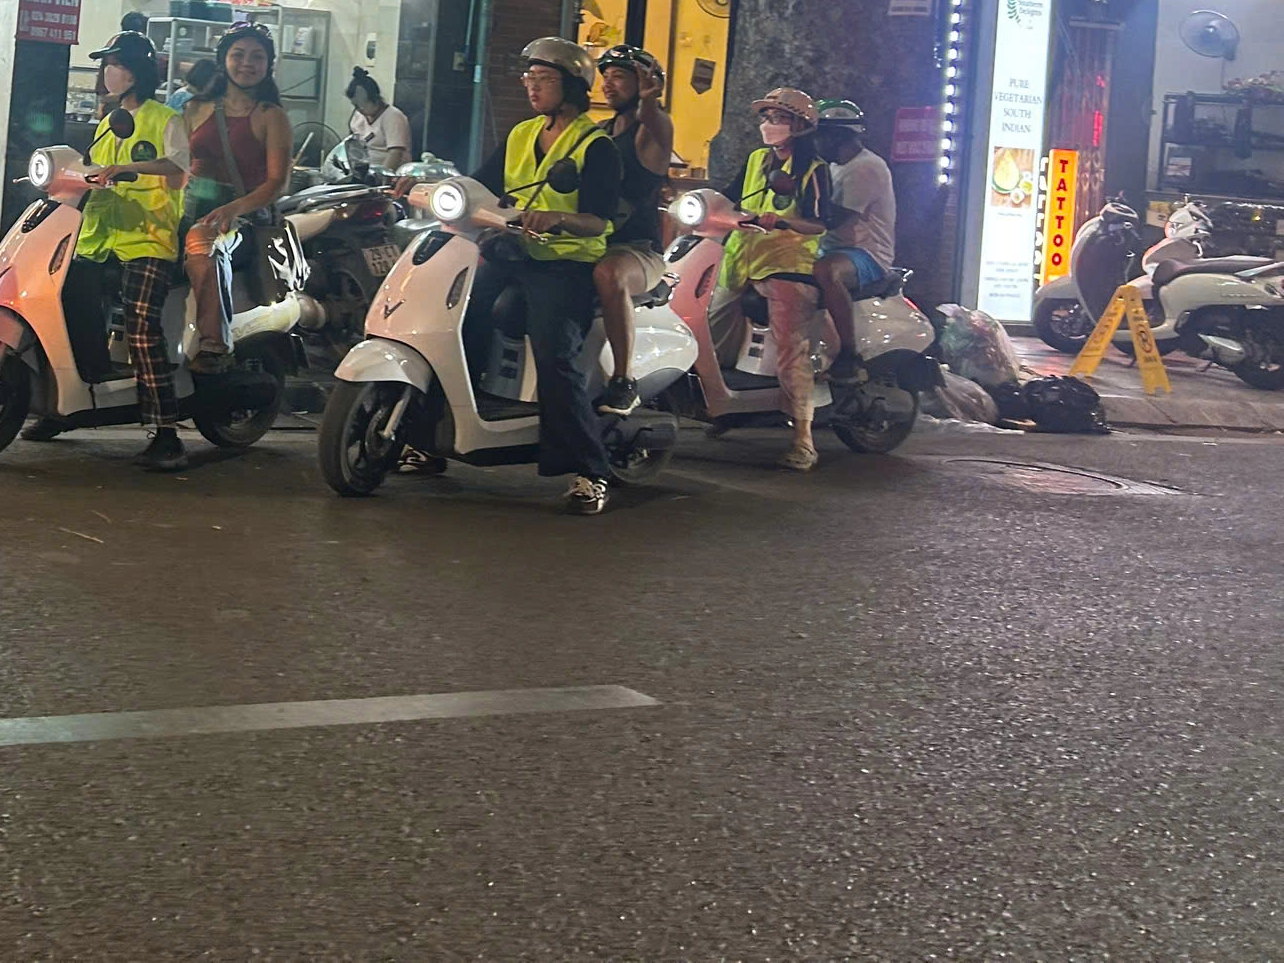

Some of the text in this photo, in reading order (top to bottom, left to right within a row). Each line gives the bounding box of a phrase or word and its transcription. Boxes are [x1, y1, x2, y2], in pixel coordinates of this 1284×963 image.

[1009, 78, 1029, 89] PURE
[994, 92, 1043, 105] VEGETARIAN
[1003, 108, 1031, 119] SOUTH
[1002, 122, 1032, 134] INDIAN
[1051, 159, 1069, 267] TATTOO
